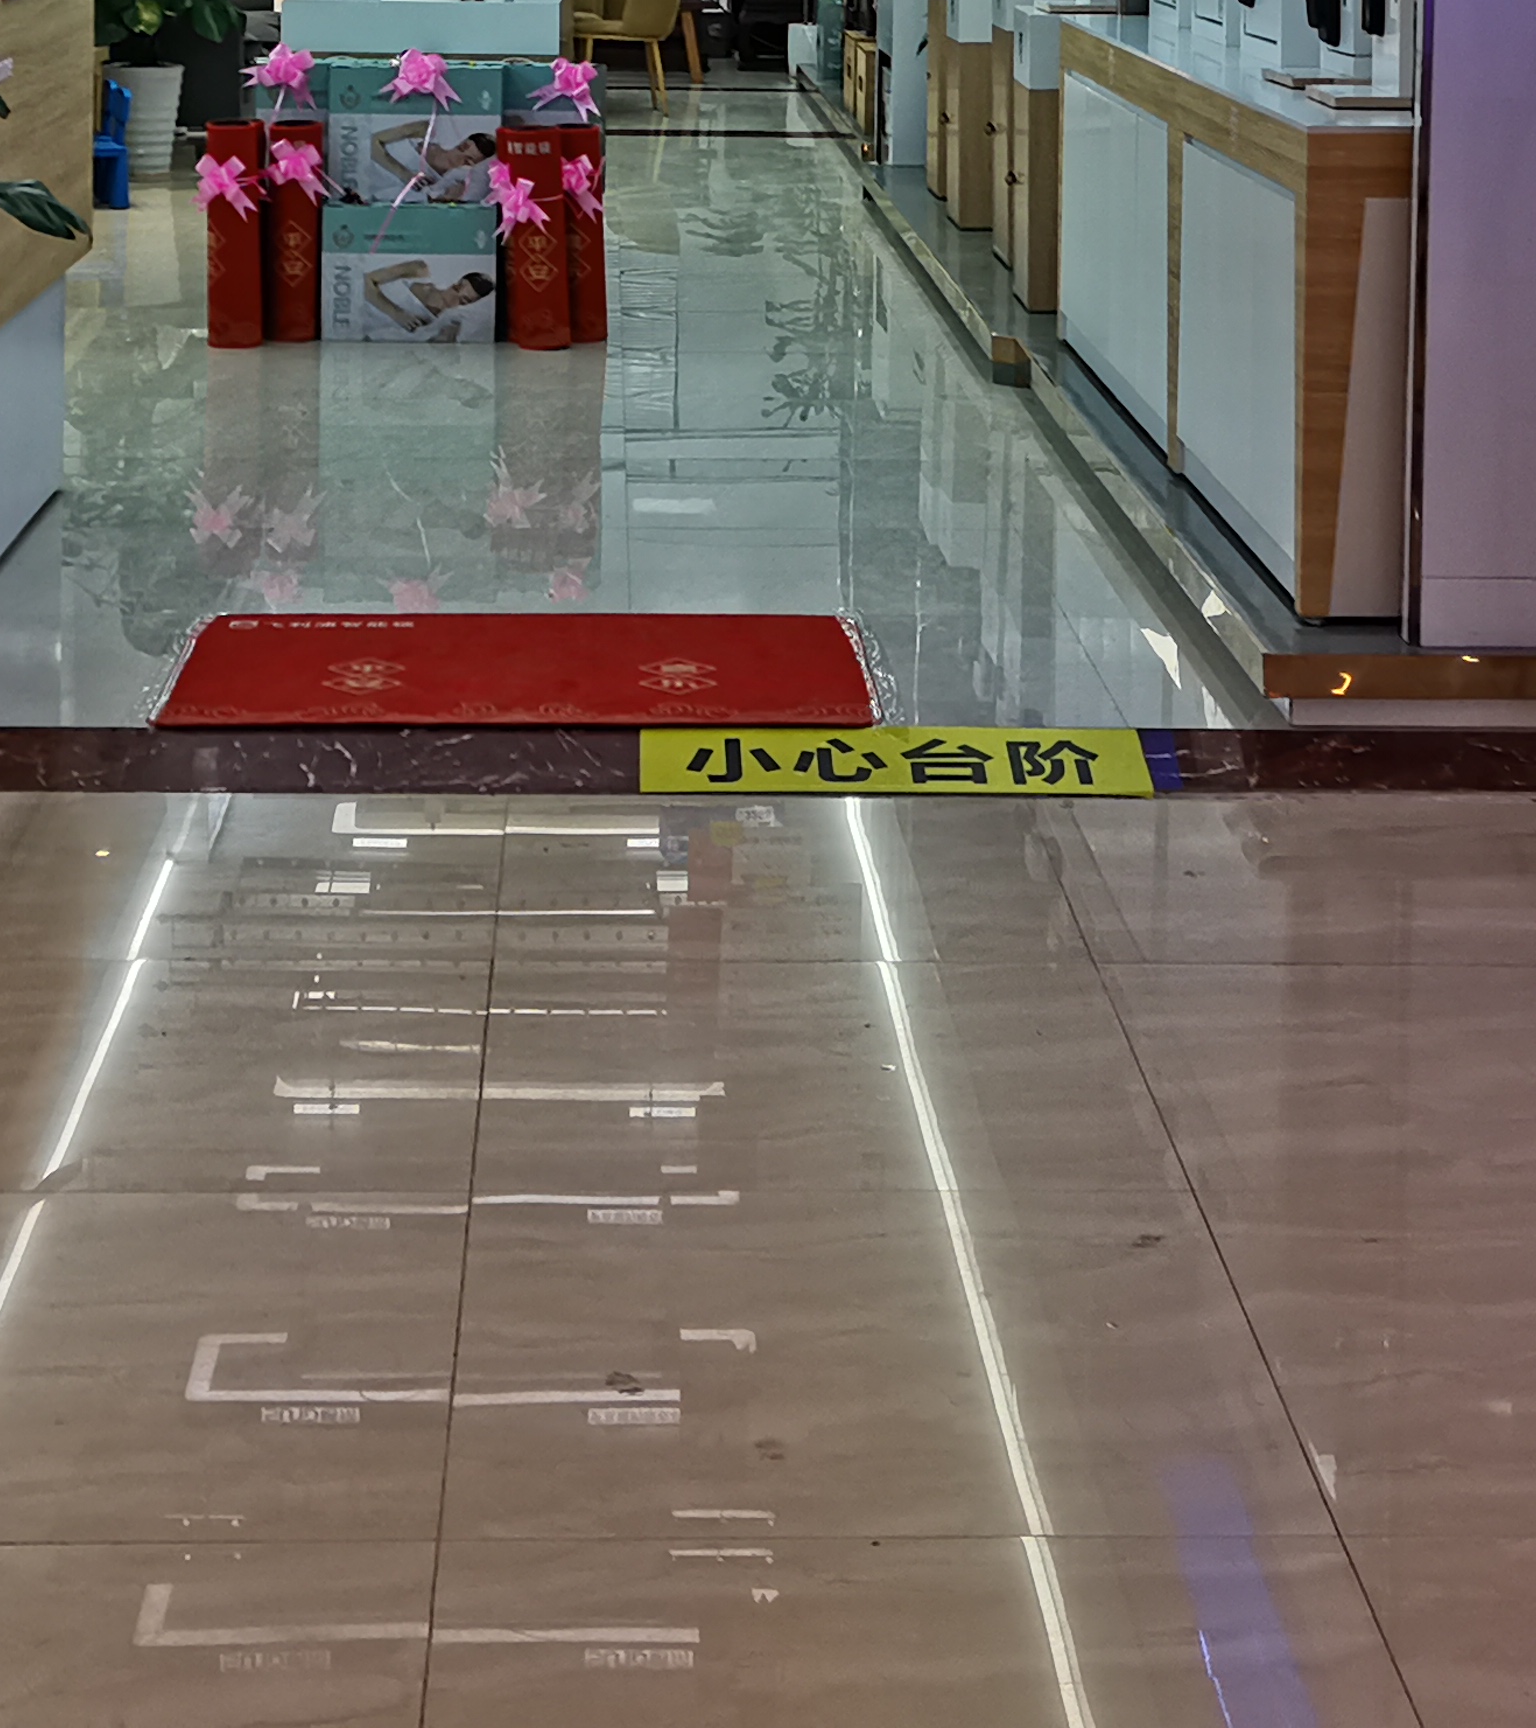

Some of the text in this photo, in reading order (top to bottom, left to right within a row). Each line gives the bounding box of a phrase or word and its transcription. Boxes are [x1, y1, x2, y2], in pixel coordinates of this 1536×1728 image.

[332, 264, 352, 329] NOBLE
[685, 738, 1102, 787] 小心台阶
